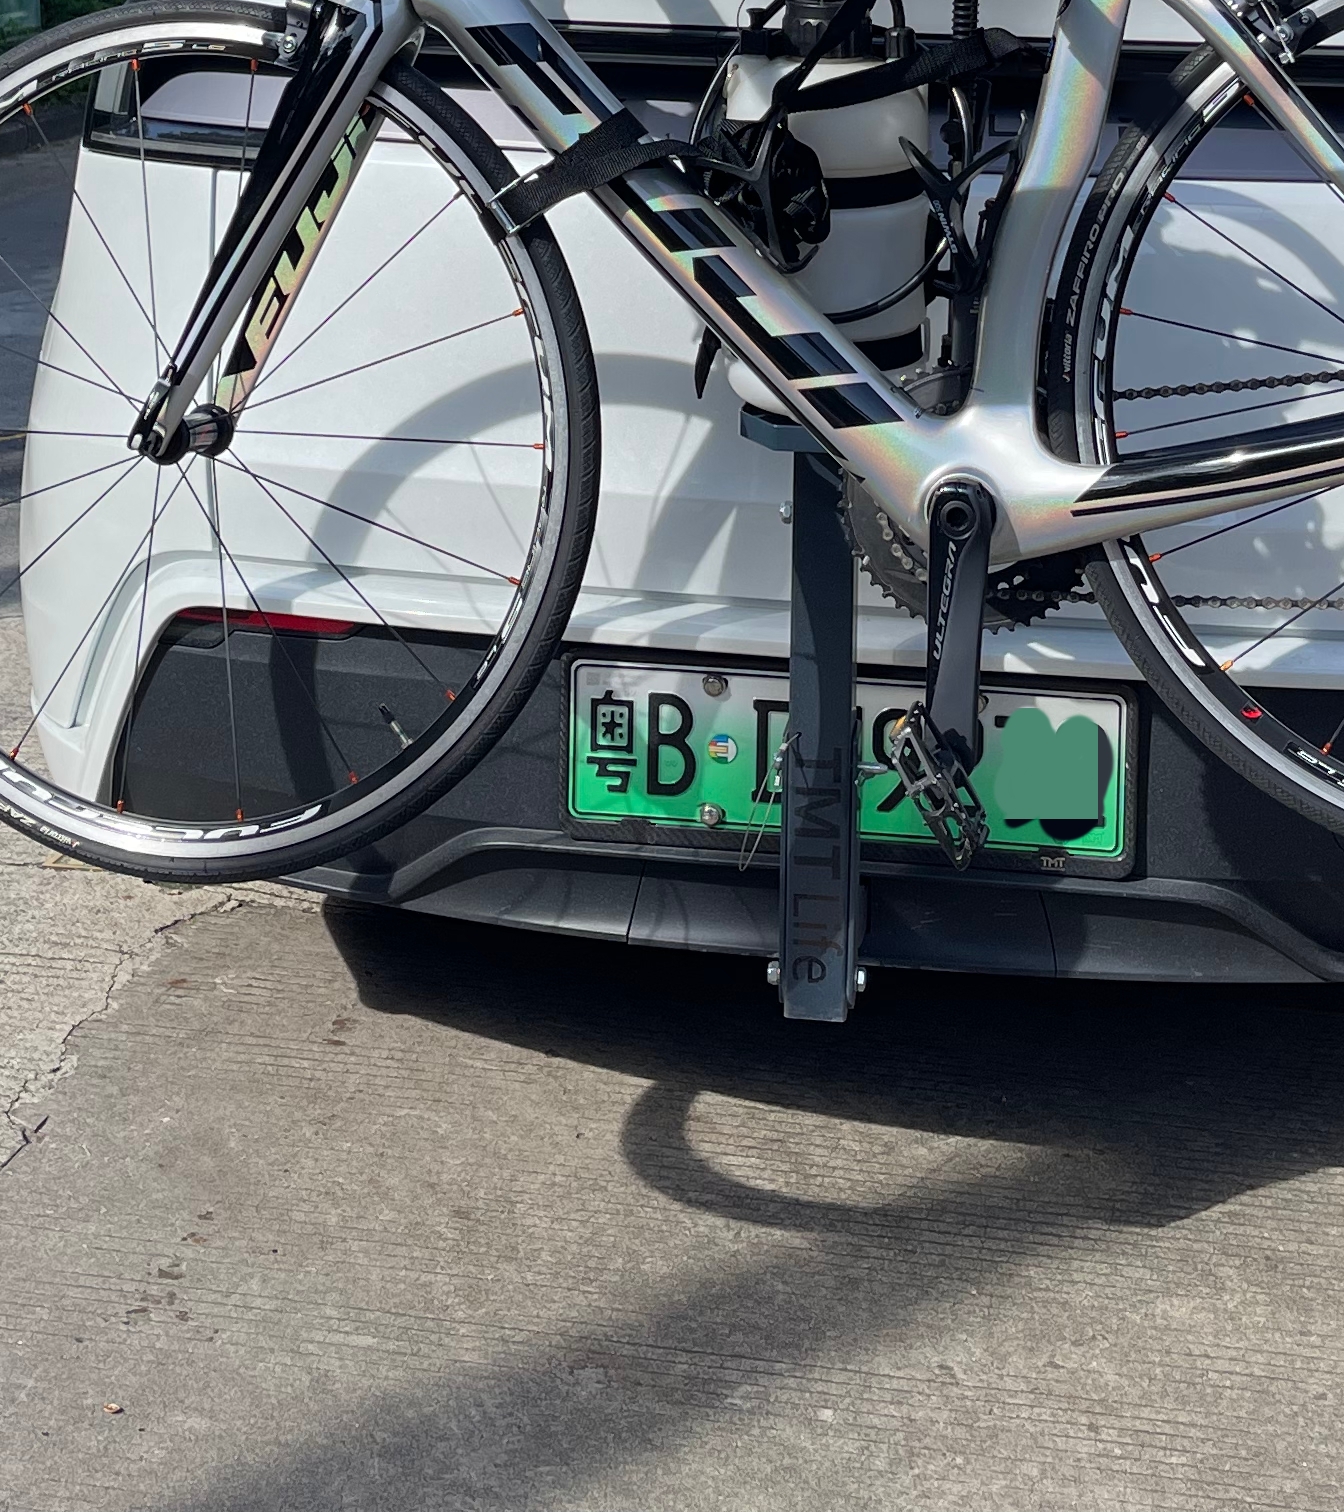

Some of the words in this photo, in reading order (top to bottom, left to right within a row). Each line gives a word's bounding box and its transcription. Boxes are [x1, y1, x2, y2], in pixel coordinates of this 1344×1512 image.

[1064, 221, 1103, 326] ZAFFIRO
[1095, 171, 1126, 223] PRO
[933, 541, 956, 660] ULTEGRA
[791, 747, 842, 879] TMT
